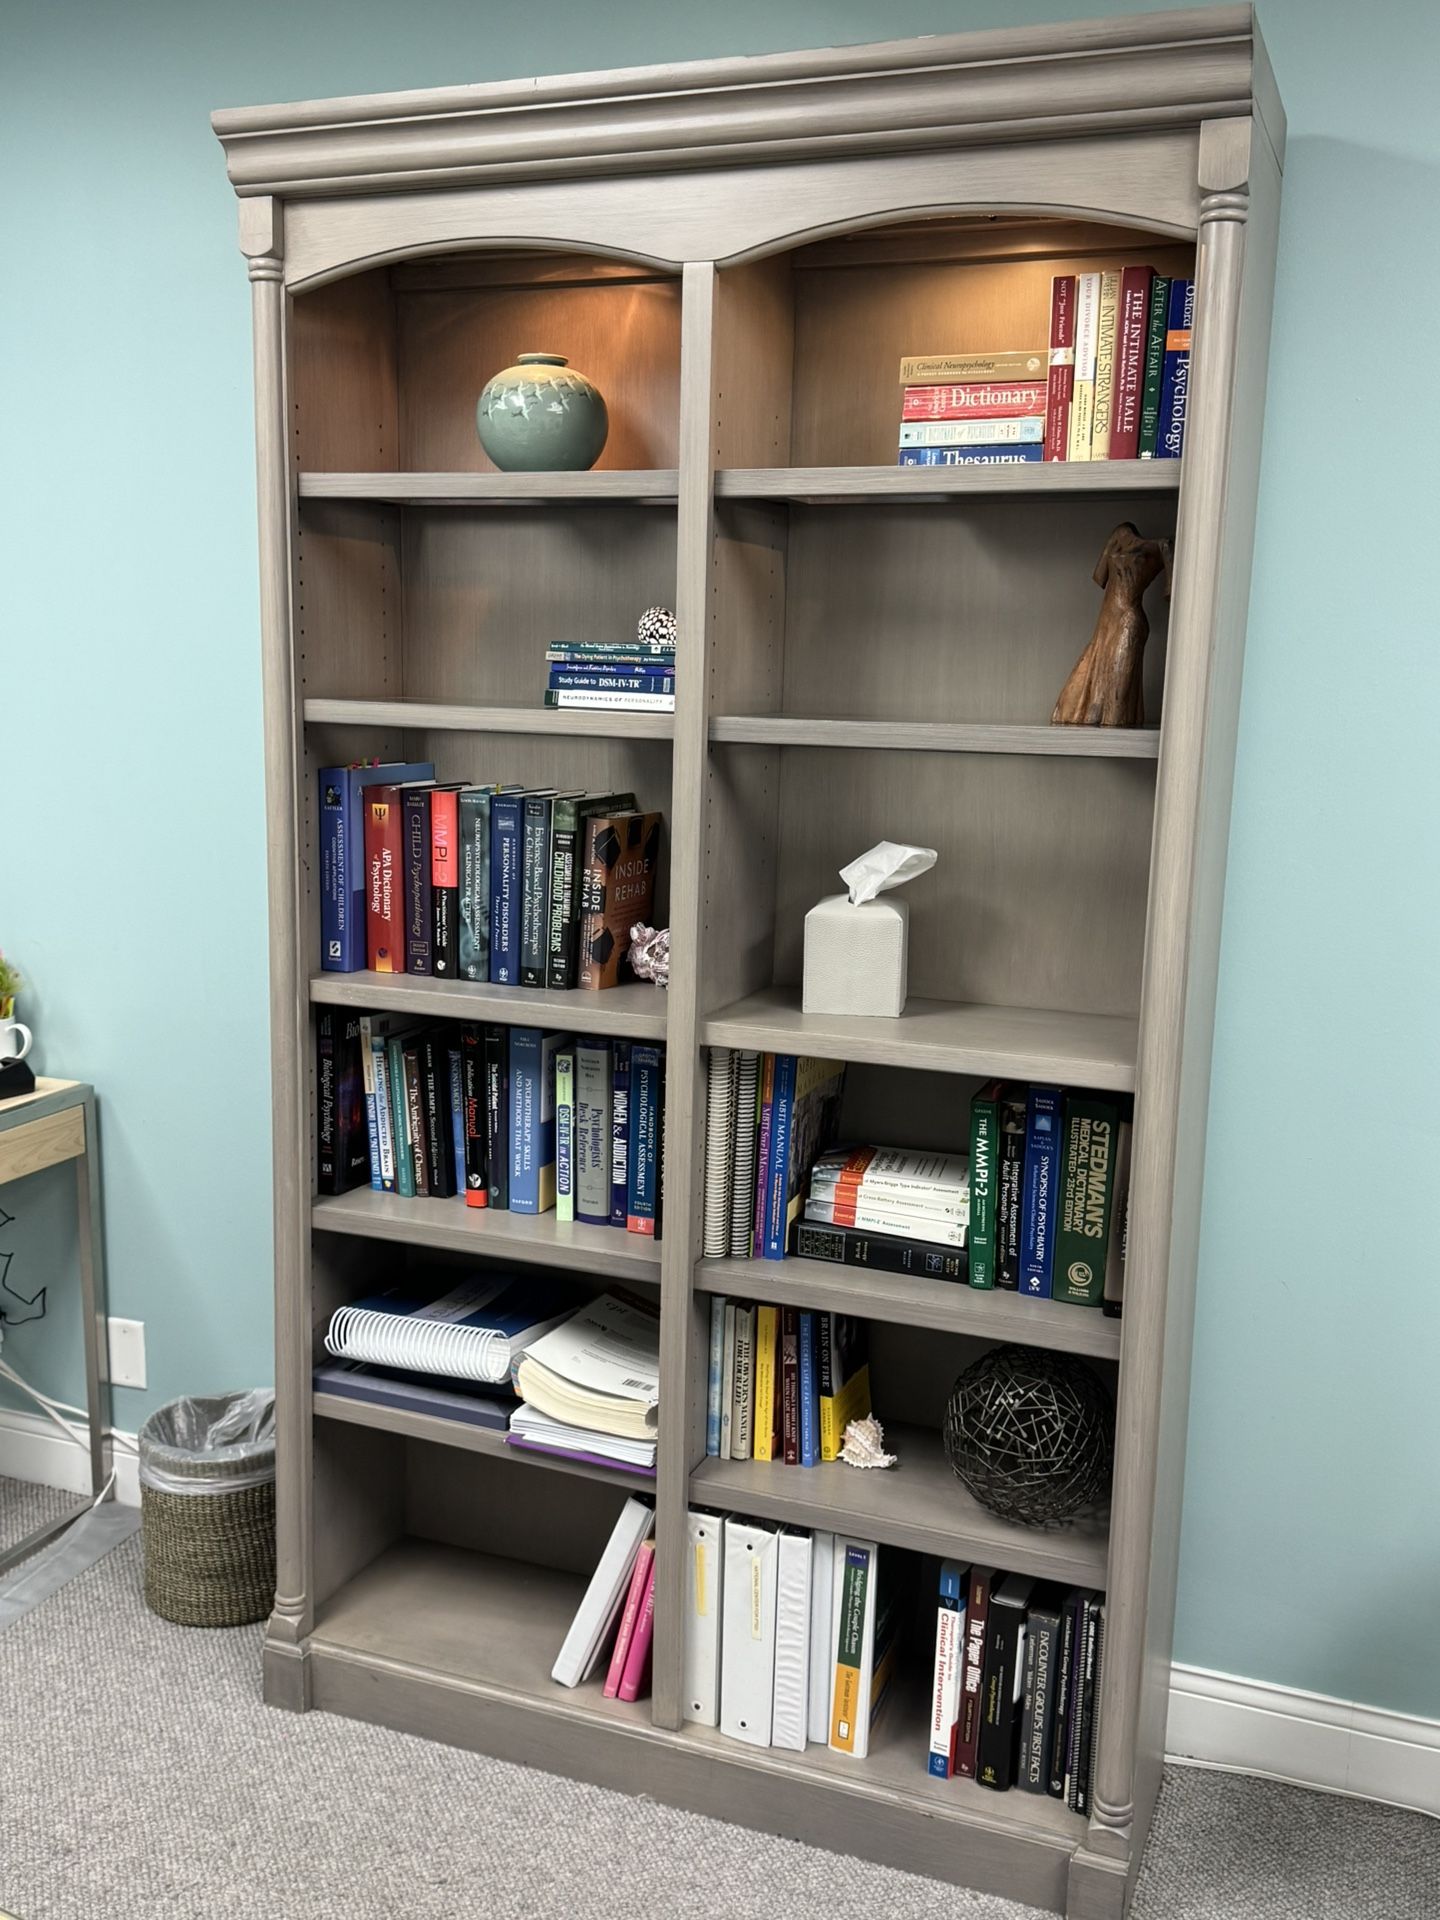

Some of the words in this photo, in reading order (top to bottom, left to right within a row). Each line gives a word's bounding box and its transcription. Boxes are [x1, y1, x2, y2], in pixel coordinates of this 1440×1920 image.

[1132, 289, 1144, 318] THE
[1153, 280, 1168, 316] AFTER
[1083, 303, 1091, 339] DIVORCE
[1101, 305, 1116, 360] INTIMATE
[1151, 319, 1162, 332] the
[917, 361, 943, 371] Clinical
[1081, 342, 1089, 377] ADVISOR
[1126, 323, 1142, 391] INTIMATE
[1148, 335, 1162, 377] AFFAIR
[951, 386, 1040, 410] Dictionary
[1095, 363, 1112, 434] STRANGERS
[1123, 395, 1136, 433] MALE
[1165, 357, 1190, 454] Psychology
[943, 450, 1026, 465] Thesaurus
[559, 677, 573, 686] Study
[336, 818, 344, 873] ASSESSMENT
[411, 815, 422, 858] CHILD
[382, 847, 391, 867] APA
[464, 852, 472, 884] CLINICAL
[473, 818, 482, 903] NEUROPSYCHOLOGICAL
[503, 838, 511, 899] PERSONALITY
[525, 837, 535, 877] Children
[533, 827, 546, 892] Evidence-Based
[615, 859, 649, 880] INSIDE
[337, 874, 344, 885] OF
[372, 861, 382, 913] Psychology
[553, 851, 567, 901] CHILDHOOD
[582, 868, 591, 908] REHAB
[591, 869, 602, 911] INSIDE
[615, 881, 646, 902] REHAB
[381, 869, 392, 921] Dictionary
[410, 861, 422, 937] Psychopathology
[473, 904, 482, 951] ASSESSMENT
[501, 902, 510, 953] DISORDERS
[523, 893, 534, 944] Adolescents
[530, 893, 544, 956] Psychotherapies
[550, 903, 564, 953] PROBLEMS
[322, 1058, 333, 1097] Biological
[375, 1055, 385, 1091] HEALING
[427, 1072, 435, 1091] THE
[466, 1060, 475, 1097] Publication
[515, 1069, 524, 1087] AND
[408, 1086, 418, 1103] The
[491, 1092, 499, 1110] Patient
[515, 1088, 523, 1127] METHODS
[524, 1078, 533, 1143] PSYCHOTHERAPY
[613, 1091, 627, 1124] WOMEN
[638, 1069, 649, 1140] PSYCHOLOGICAL
[778, 1099, 788, 1122] MBTI
[322, 1099, 333, 1143] Psychology
[379, 1104, 390, 1146] ADDICTED
[410, 1103, 422, 1142] Ambiguity
[430, 1116, 438, 1141] Second
[468, 1096, 481, 1138] Manual
[559, 1108, 570, 1145] DSM-IV-TR
[579, 1102, 589, 1123] Desk
[613, 1124, 622, 1135] &
[762, 1107, 771, 1130] MBTI
[978, 1118, 987, 1136] THE
[413, 1142, 422, 1153] of
[431, 1141, 439, 1168] Edition
[514, 1129, 522, 1151] THAT
[523, 1144, 531, 1170] SKILLS
[578, 1127, 589, 1173] Reference
[647, 1152, 653, 1163] OF
[775, 1124, 787, 1170] MANUAL
[1068, 1117, 1080, 1173] ILLUSTRATED
[1077, 1118, 1091, 1165] MEDICAL
[383, 1148, 392, 1173] BRAIN
[414, 1152, 424, 1185] Change
[514, 1152, 522, 1177] WORK
[559, 1155, 570, 1192] ACTION
[612, 1136, 627, 1185] ADDICTION
[636, 1142, 646, 1197] ASSESSMENT
[758, 1156, 768, 1185] MANUAL
[974, 1138, 989, 1196] MMPI-2
[1002, 1160, 1011, 1180] Adult
[1039, 1155, 1050, 1198] SYNOPSIS
[1011, 1161, 1021, 1202] Integrative
[1066, 1177, 1076, 1198] 23rd
[1084, 1120, 1111, 1239] STEDMAN'S
[1000, 1182, 1010, 1223] Personality
[1039, 1198, 1048, 1210] OF
[1063, 1199, 1075, 1232] EDITION
[1072, 1168, 1088, 1234] DICTIONARY
[1009, 1203, 1020, 1246] Assessment
[1036, 1211, 1047, 1262] PSYCHIATRY
[1009, 1247, 1017, 1257] of
[736, 1339, 744, 1358] FOR
[820, 1317, 830, 1346] BRAIN
[742, 1341, 750, 1361] THE
[821, 1349, 829, 1363] ON
[735, 1359, 744, 1385] YOUR
[821, 1365, 830, 1388] FIRE
[735, 1385, 743, 1407] LIFE
[739, 1404, 748, 1443] MANUAL
[854, 1569, 864, 1597] Bridging
[851, 1608, 861, 1631] Couple
[854, 1597, 862, 1607] the
[850, 1632, 859, 1654] Chasm
[939, 1613, 950, 1657] Clinical
[970, 1619, 985, 1635] The
[1064, 1615, 1073, 1649] Attachment
[967, 1637, 984, 1665] Paper
[1028, 1634, 1037, 1665] Lieberman
[1036, 1631, 1050, 1689] ENCOUNTER
[1061, 1656, 1070, 1675] Group
[934, 1660, 947, 1731] Intervention
[965, 1666, 981, 1692] Office
[1058, 1675, 1068, 1716] Psychotherapy
[1024, 1693, 1033, 1710] Miles
[1033, 1691, 1046, 1730] GROUPS:
[1031, 1731, 1044, 1756] FIRST
[1029, 1757, 1042, 1783] FACTS
